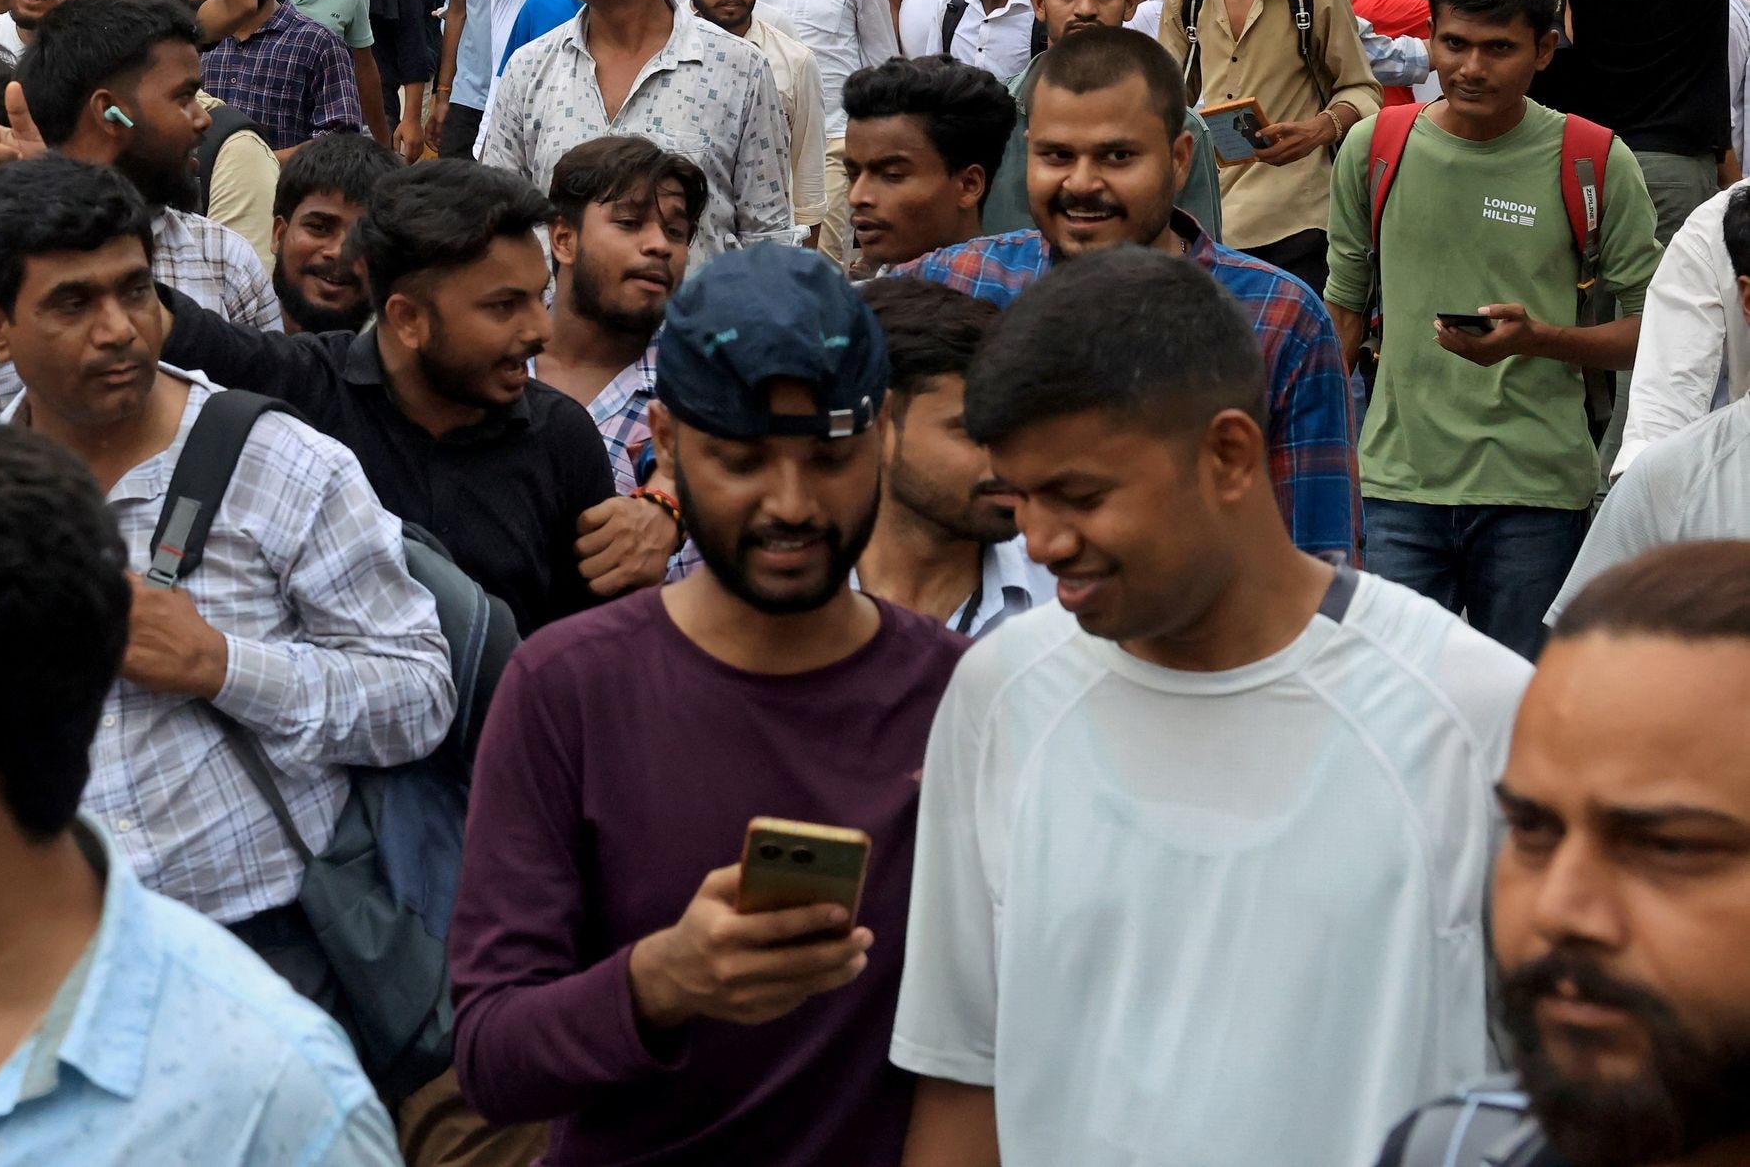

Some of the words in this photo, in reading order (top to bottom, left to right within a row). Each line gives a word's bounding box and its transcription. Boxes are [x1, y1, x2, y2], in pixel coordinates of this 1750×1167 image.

[1483, 196, 1537, 216] LONDON
[1585, 188, 1595, 220] ZIPLINE
[1482, 208, 1519, 224] HILLS
